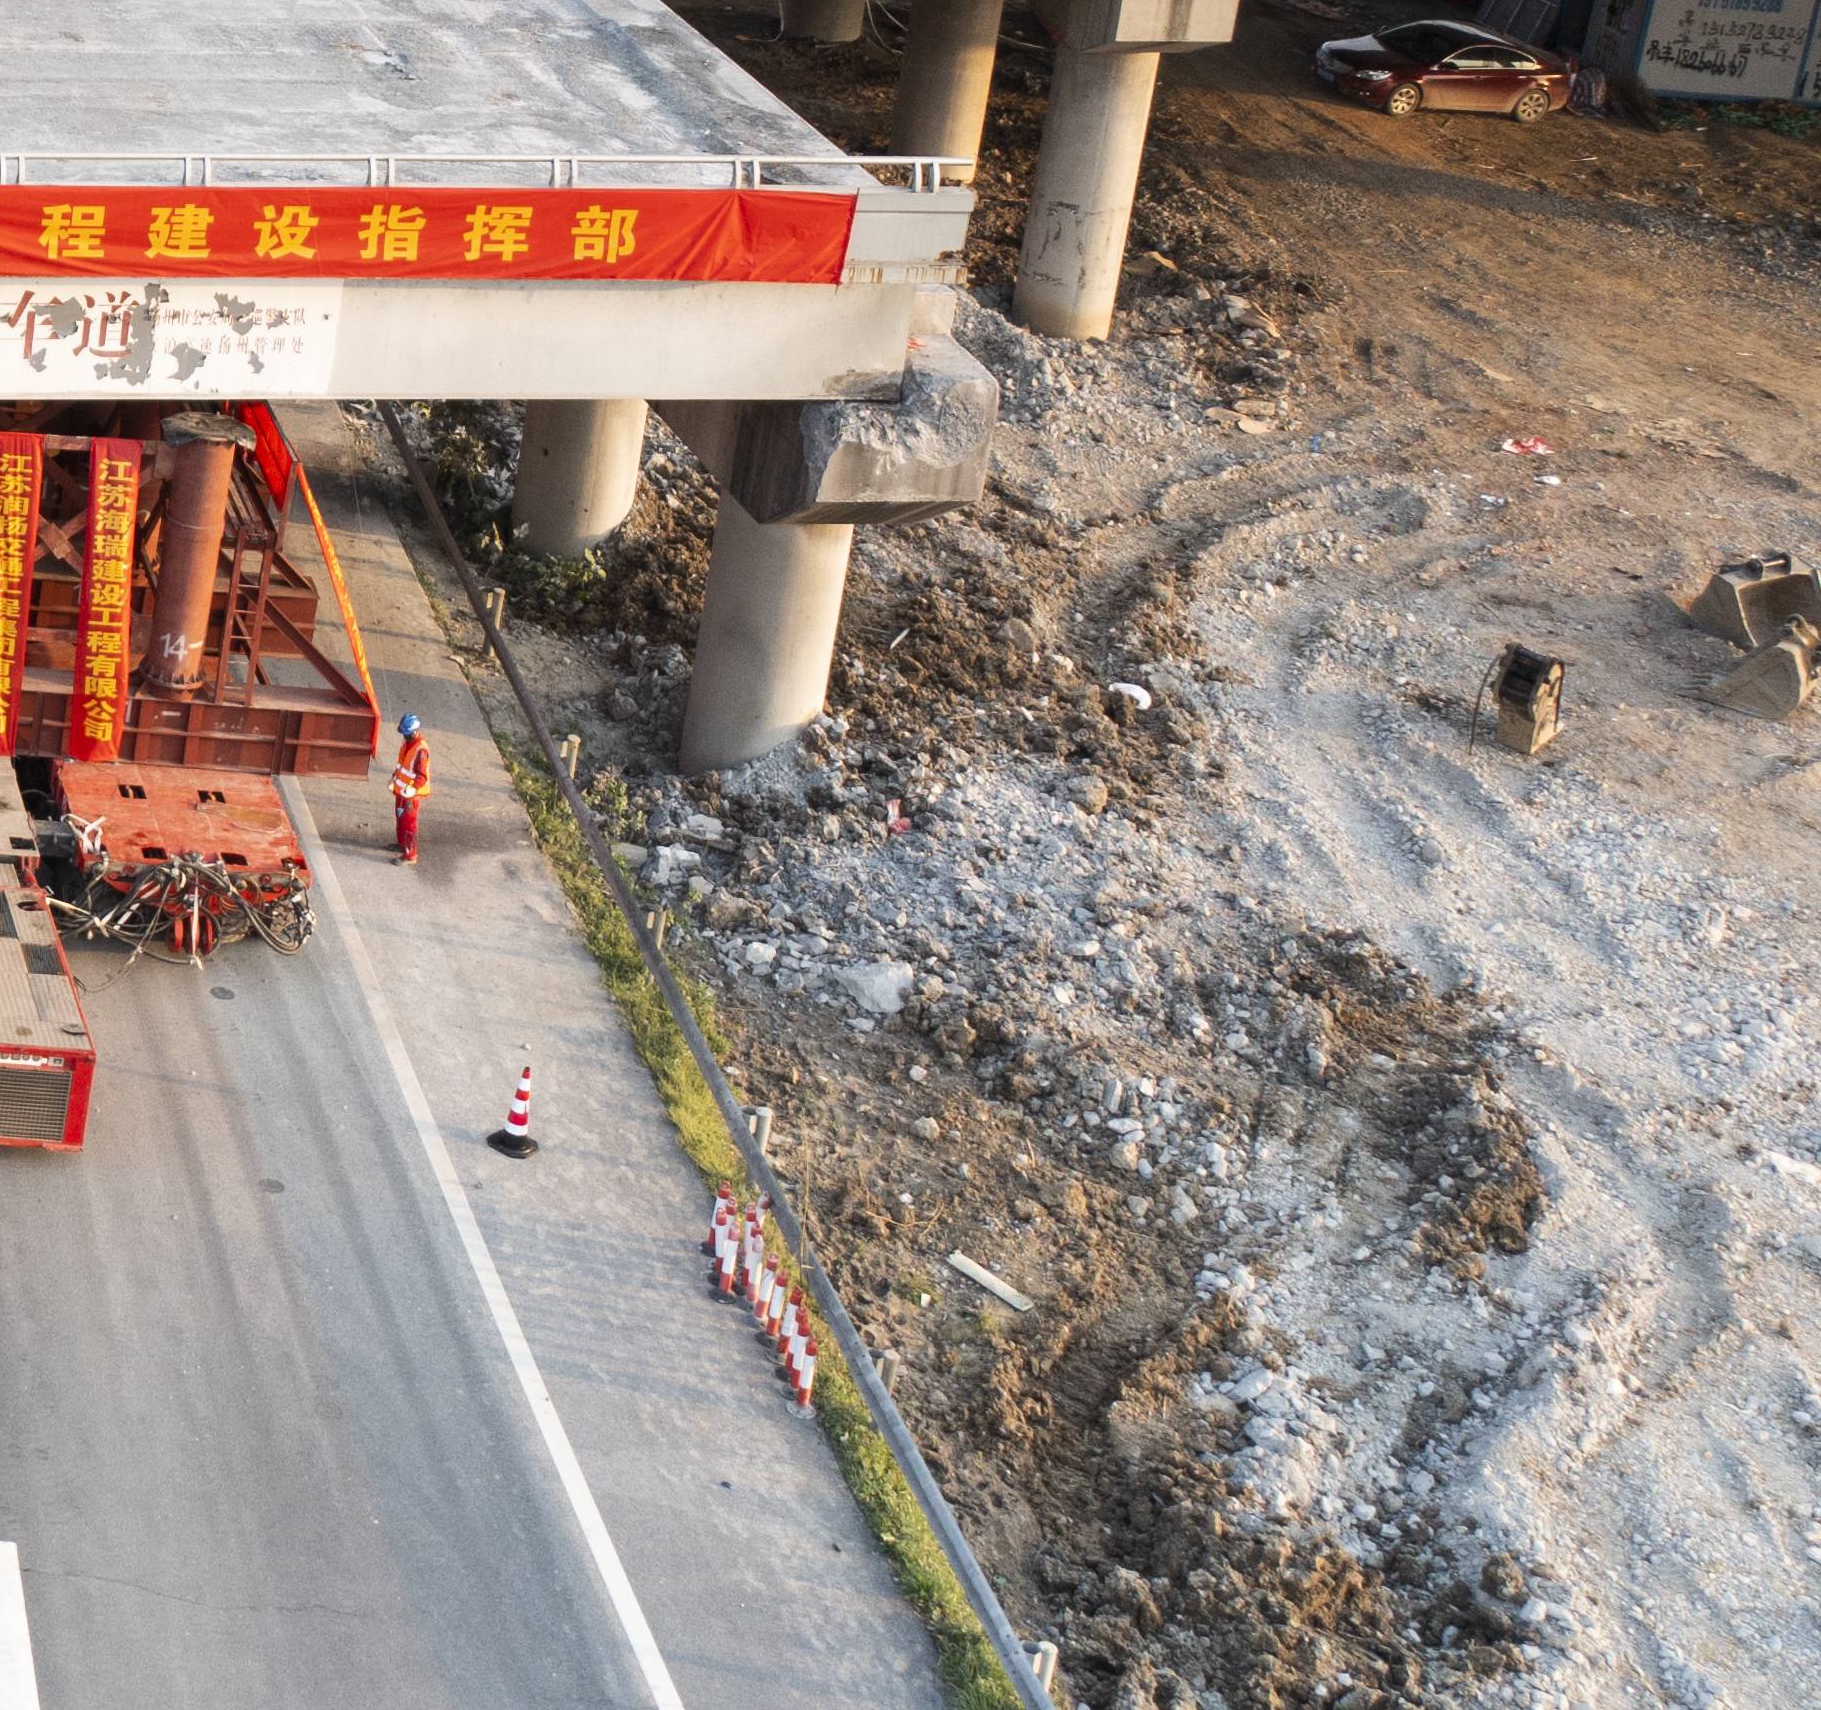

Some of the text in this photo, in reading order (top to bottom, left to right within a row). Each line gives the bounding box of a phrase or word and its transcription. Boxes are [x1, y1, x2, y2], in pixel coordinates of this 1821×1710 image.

[83, 458, 134, 742] 江苏海瑞建设工程有限公司
